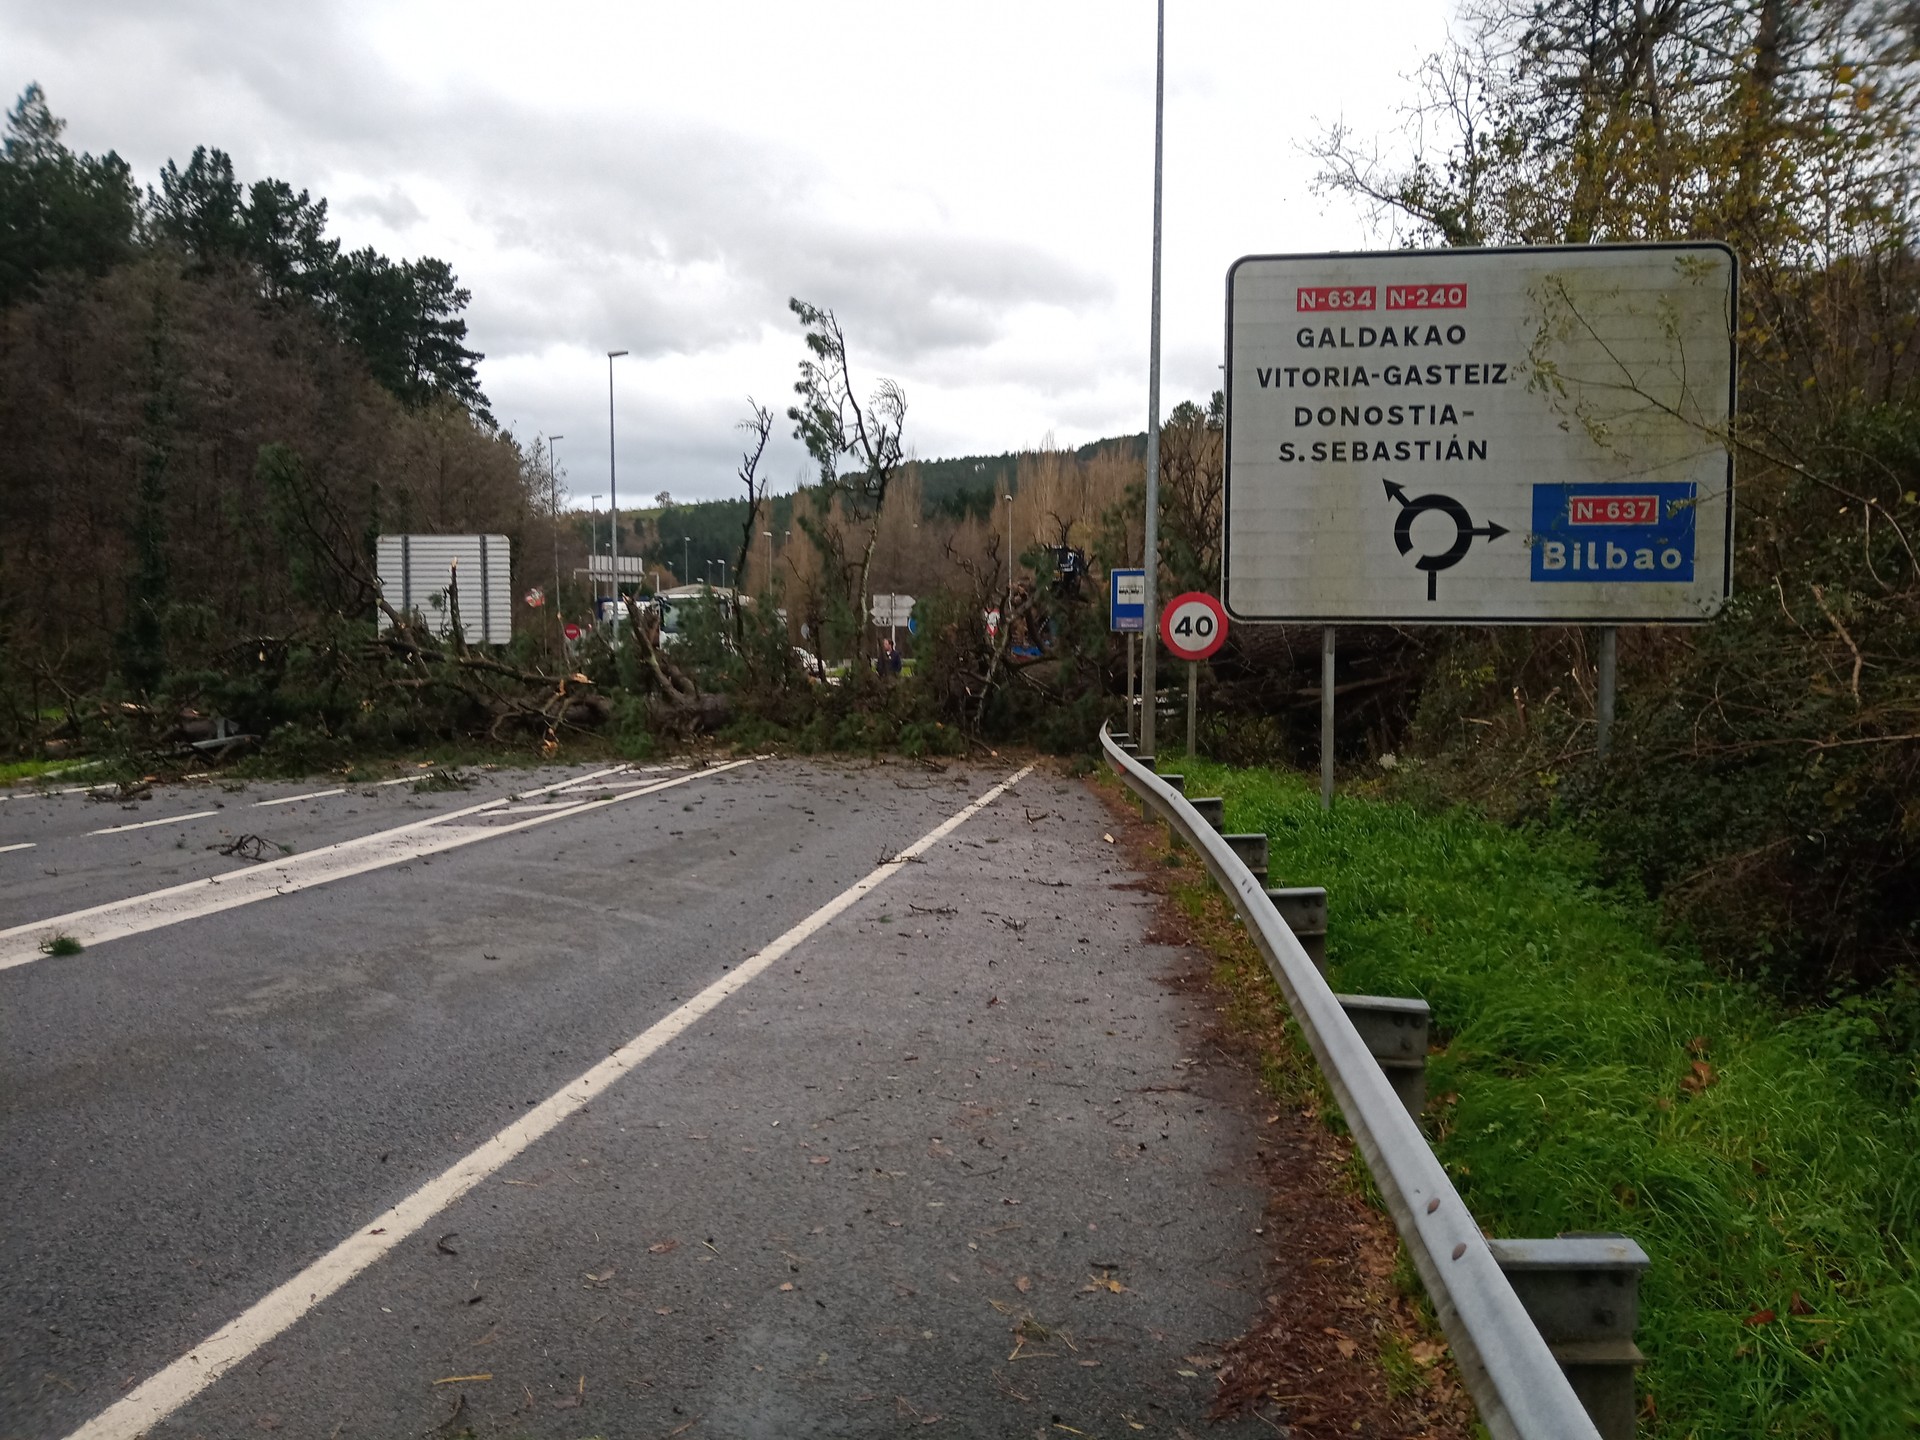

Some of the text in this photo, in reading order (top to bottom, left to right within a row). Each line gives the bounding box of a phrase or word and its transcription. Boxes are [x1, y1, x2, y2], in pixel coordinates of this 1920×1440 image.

[1300, 286, 1463, 309] N-634 N-240
[1297, 325, 1467, 349] GALDAKAO
[1257, 363, 1509, 388] VITORIA-GASTEIZ
[1294, 405, 1475, 428] DONOSTIA-
[1577, 501, 1652, 521] N-637
[1542, 541, 1683, 572] Bilbao
[1174, 615, 1214, 638] 40
